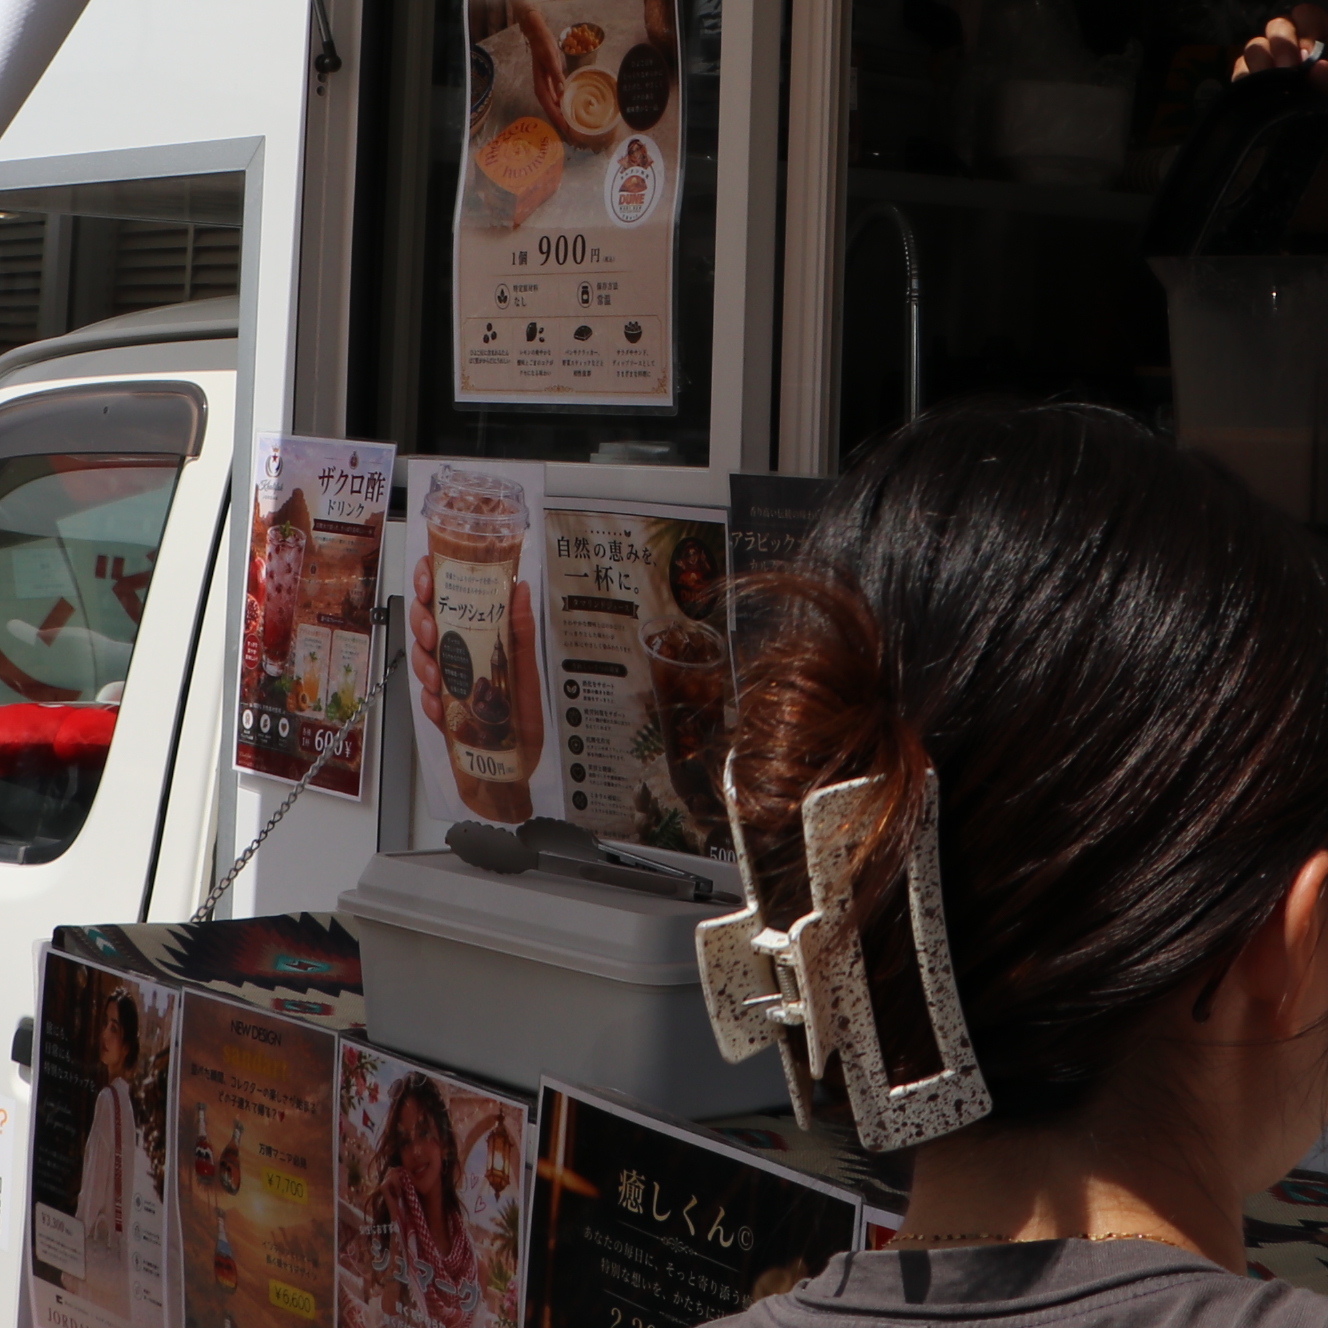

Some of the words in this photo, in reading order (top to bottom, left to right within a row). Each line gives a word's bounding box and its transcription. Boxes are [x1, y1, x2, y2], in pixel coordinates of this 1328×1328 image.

[512, 250, 528, 266] 1個
[318, 466, 386, 504] ザクロ酢
[327, 499, 365, 519] ドリンク
[557, 536, 657, 566] 自然の恵みを、
[564, 564, 639, 595] 一杯に。
[438, 596, 505, 623] デーツシェイク
[573, 599, 630, 612] タマリンドジュース
[230, 1019, 251, 1038] NEW
[251, 1025, 282, 1047] DESIGN
[266, 1172, 304, 1198] ¥7,700
[370, 1238, 482, 1312] シュマーグ
[274, 1284, 311, 1313] ¥6,600
